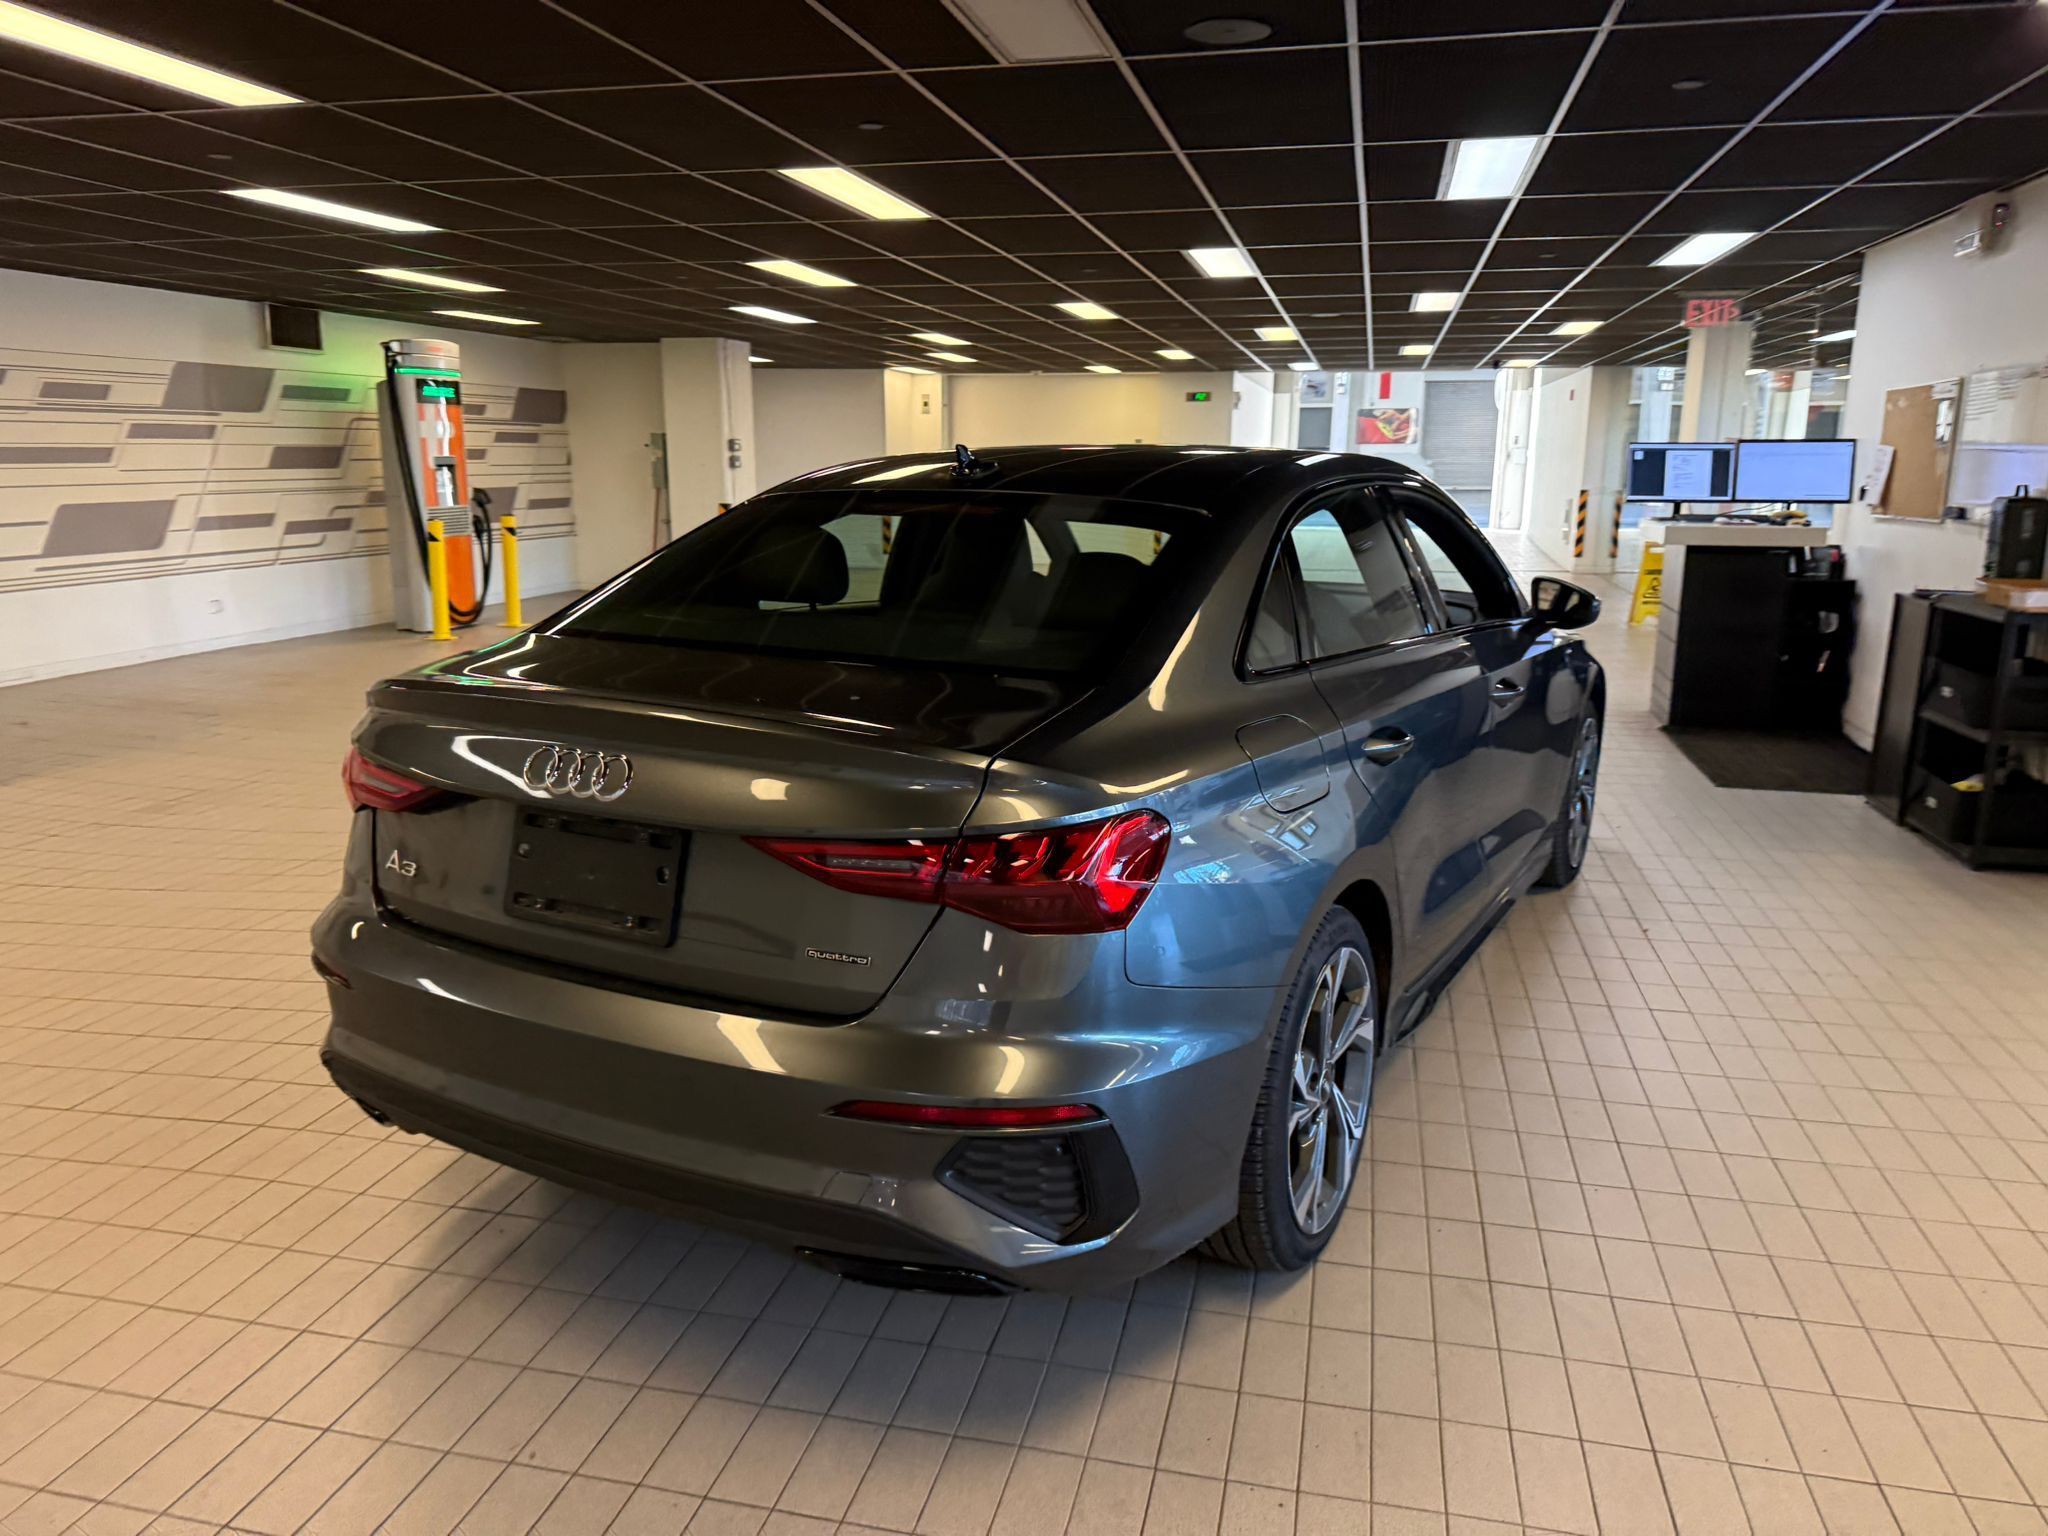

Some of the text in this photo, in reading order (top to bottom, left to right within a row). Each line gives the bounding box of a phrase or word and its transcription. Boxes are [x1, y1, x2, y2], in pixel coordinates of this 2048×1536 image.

[1685, 299, 1733, 327] EXIT
[385, 849, 417, 877] A3
[807, 950, 868, 964] quattro
